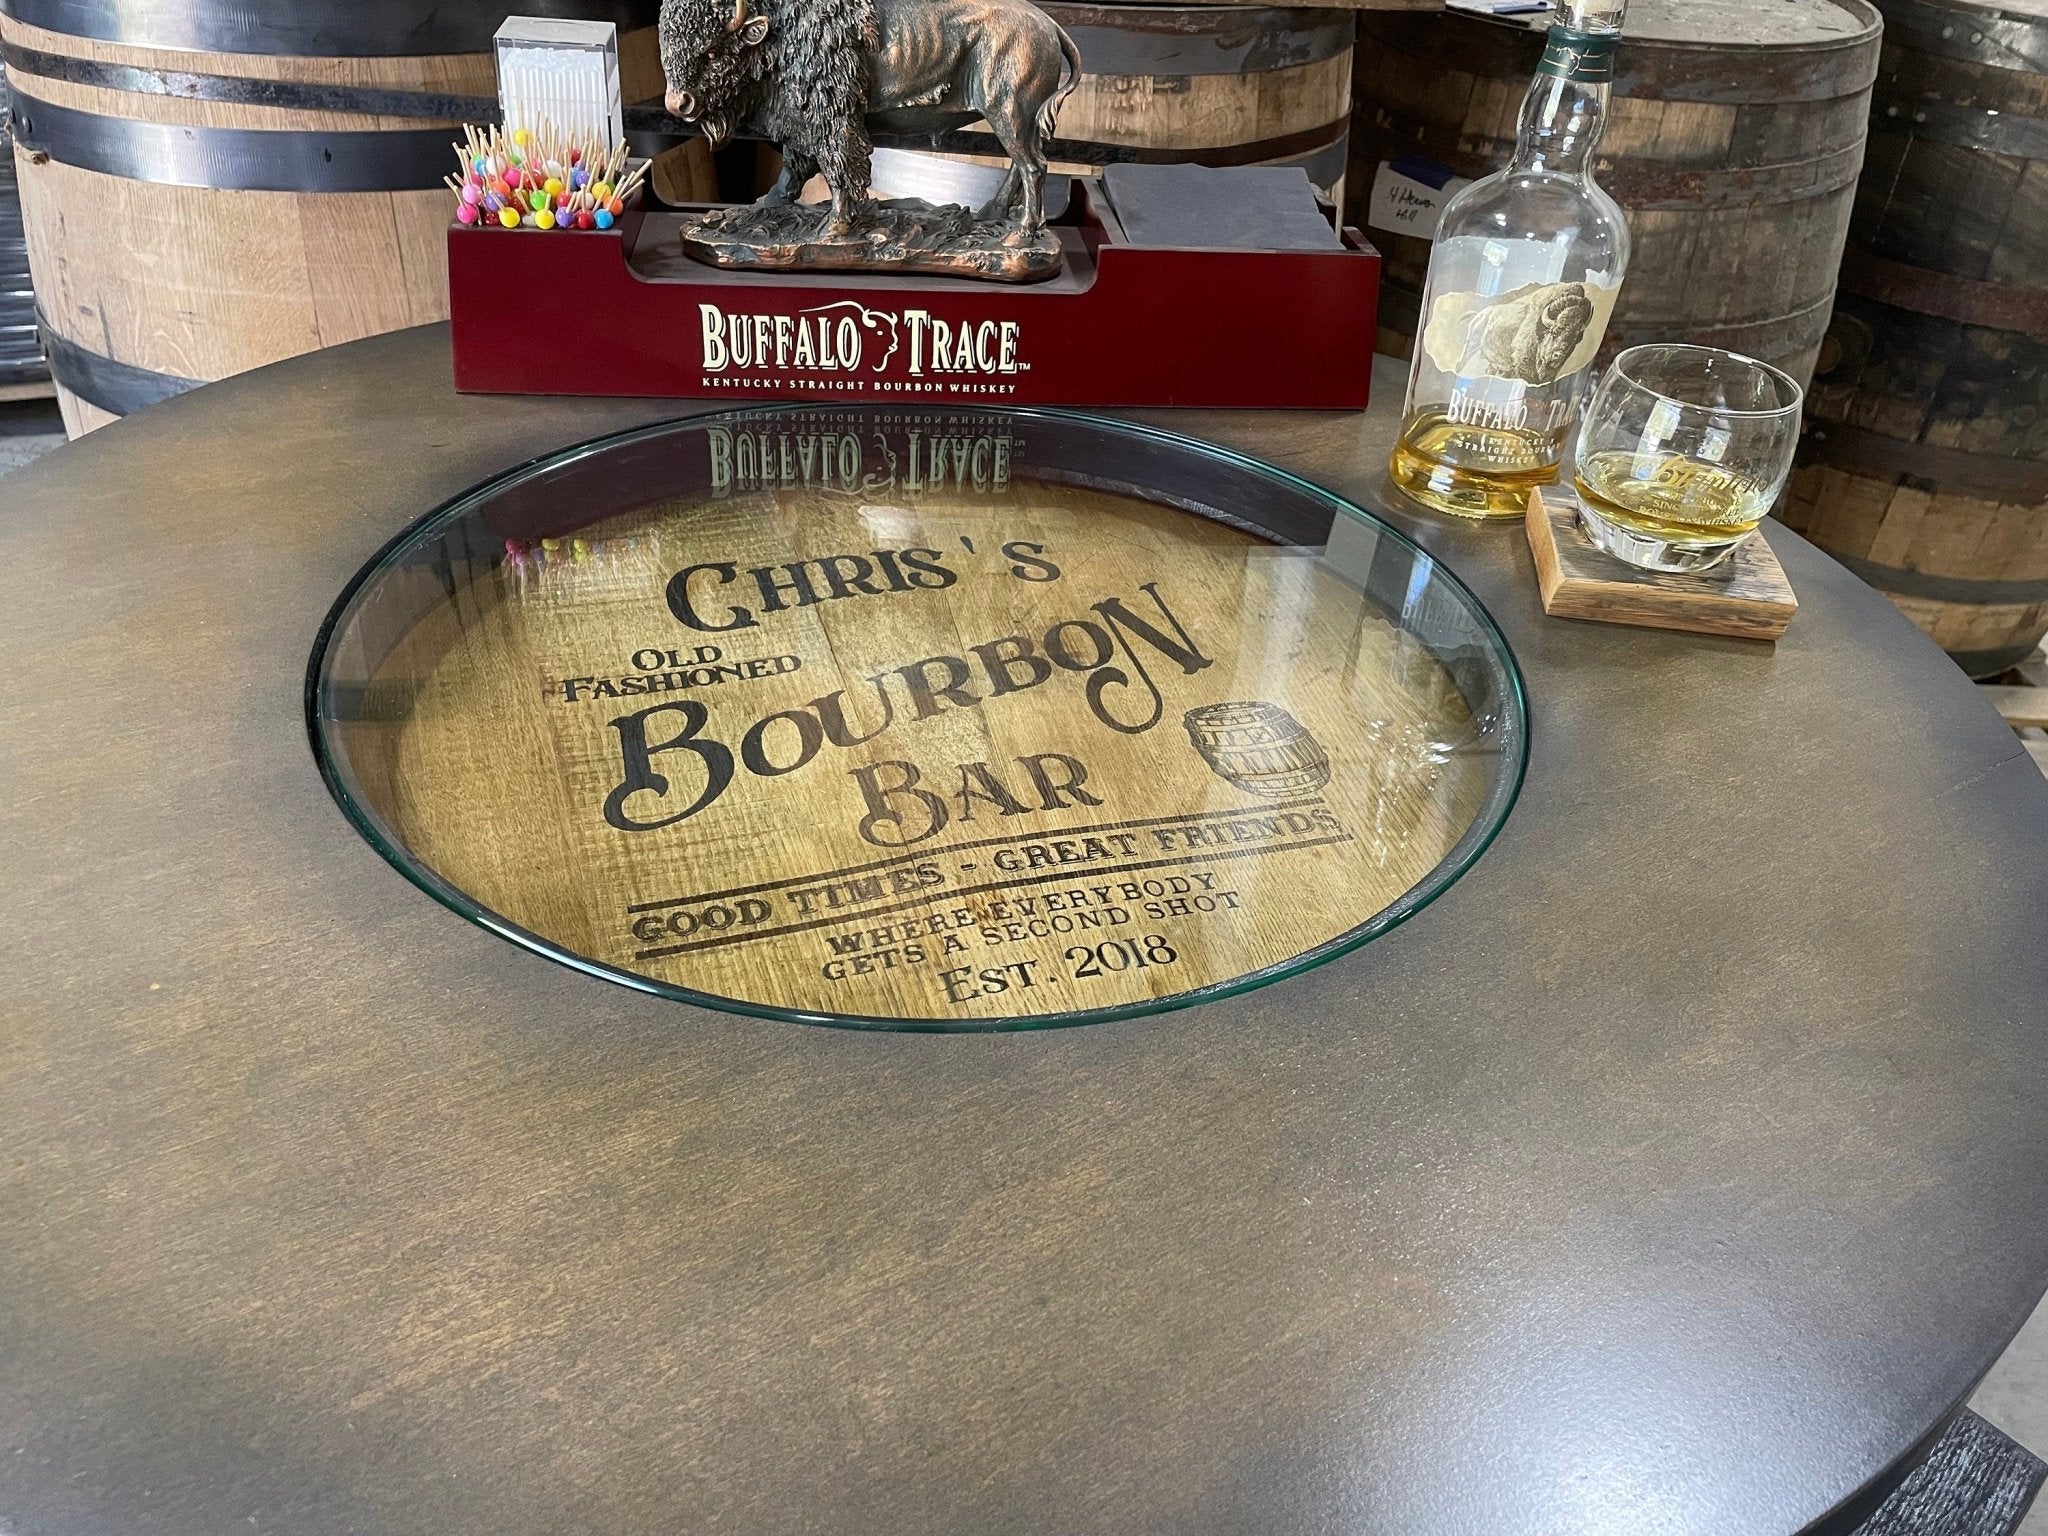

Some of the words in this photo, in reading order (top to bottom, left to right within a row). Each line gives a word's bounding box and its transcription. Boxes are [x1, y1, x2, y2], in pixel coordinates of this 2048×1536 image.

[699, 304, 862, 371] BUFFALO
[905, 310, 1020, 377] TRACE
[702, 377, 782, 389] KENTUCKY
[789, 379, 865, 391] STRAIGHT
[874, 382, 943, 392] BOURBON
[949, 383, 1016, 394] WHISKEY
[1446, 388, 1528, 431] BUFFALO
[561, 655, 802, 702] FASHIONED
[631, 645, 723, 671] OLD
[603, 582, 1213, 832] BOURBON
[846, 752, 1104, 848] BAR
[632, 898, 772, 943] GOOD
[786, 860, 946, 915] TIMES
[994, 833, 1138, 873] GREAT
[1149, 808, 1341, 851] FRIENDS
[822, 943, 925, 981] GETS
[943, 934, 969, 956] A
[980, 907, 1131, 946] SECOND
[1144, 891, 1239, 920] SHOT
[825, 903, 976, 955] WHERE
[988, 872, 1216, 921] EVERYBODY
[938, 959, 1058, 1004] EST.
[1064, 934, 1178, 979] 2018
